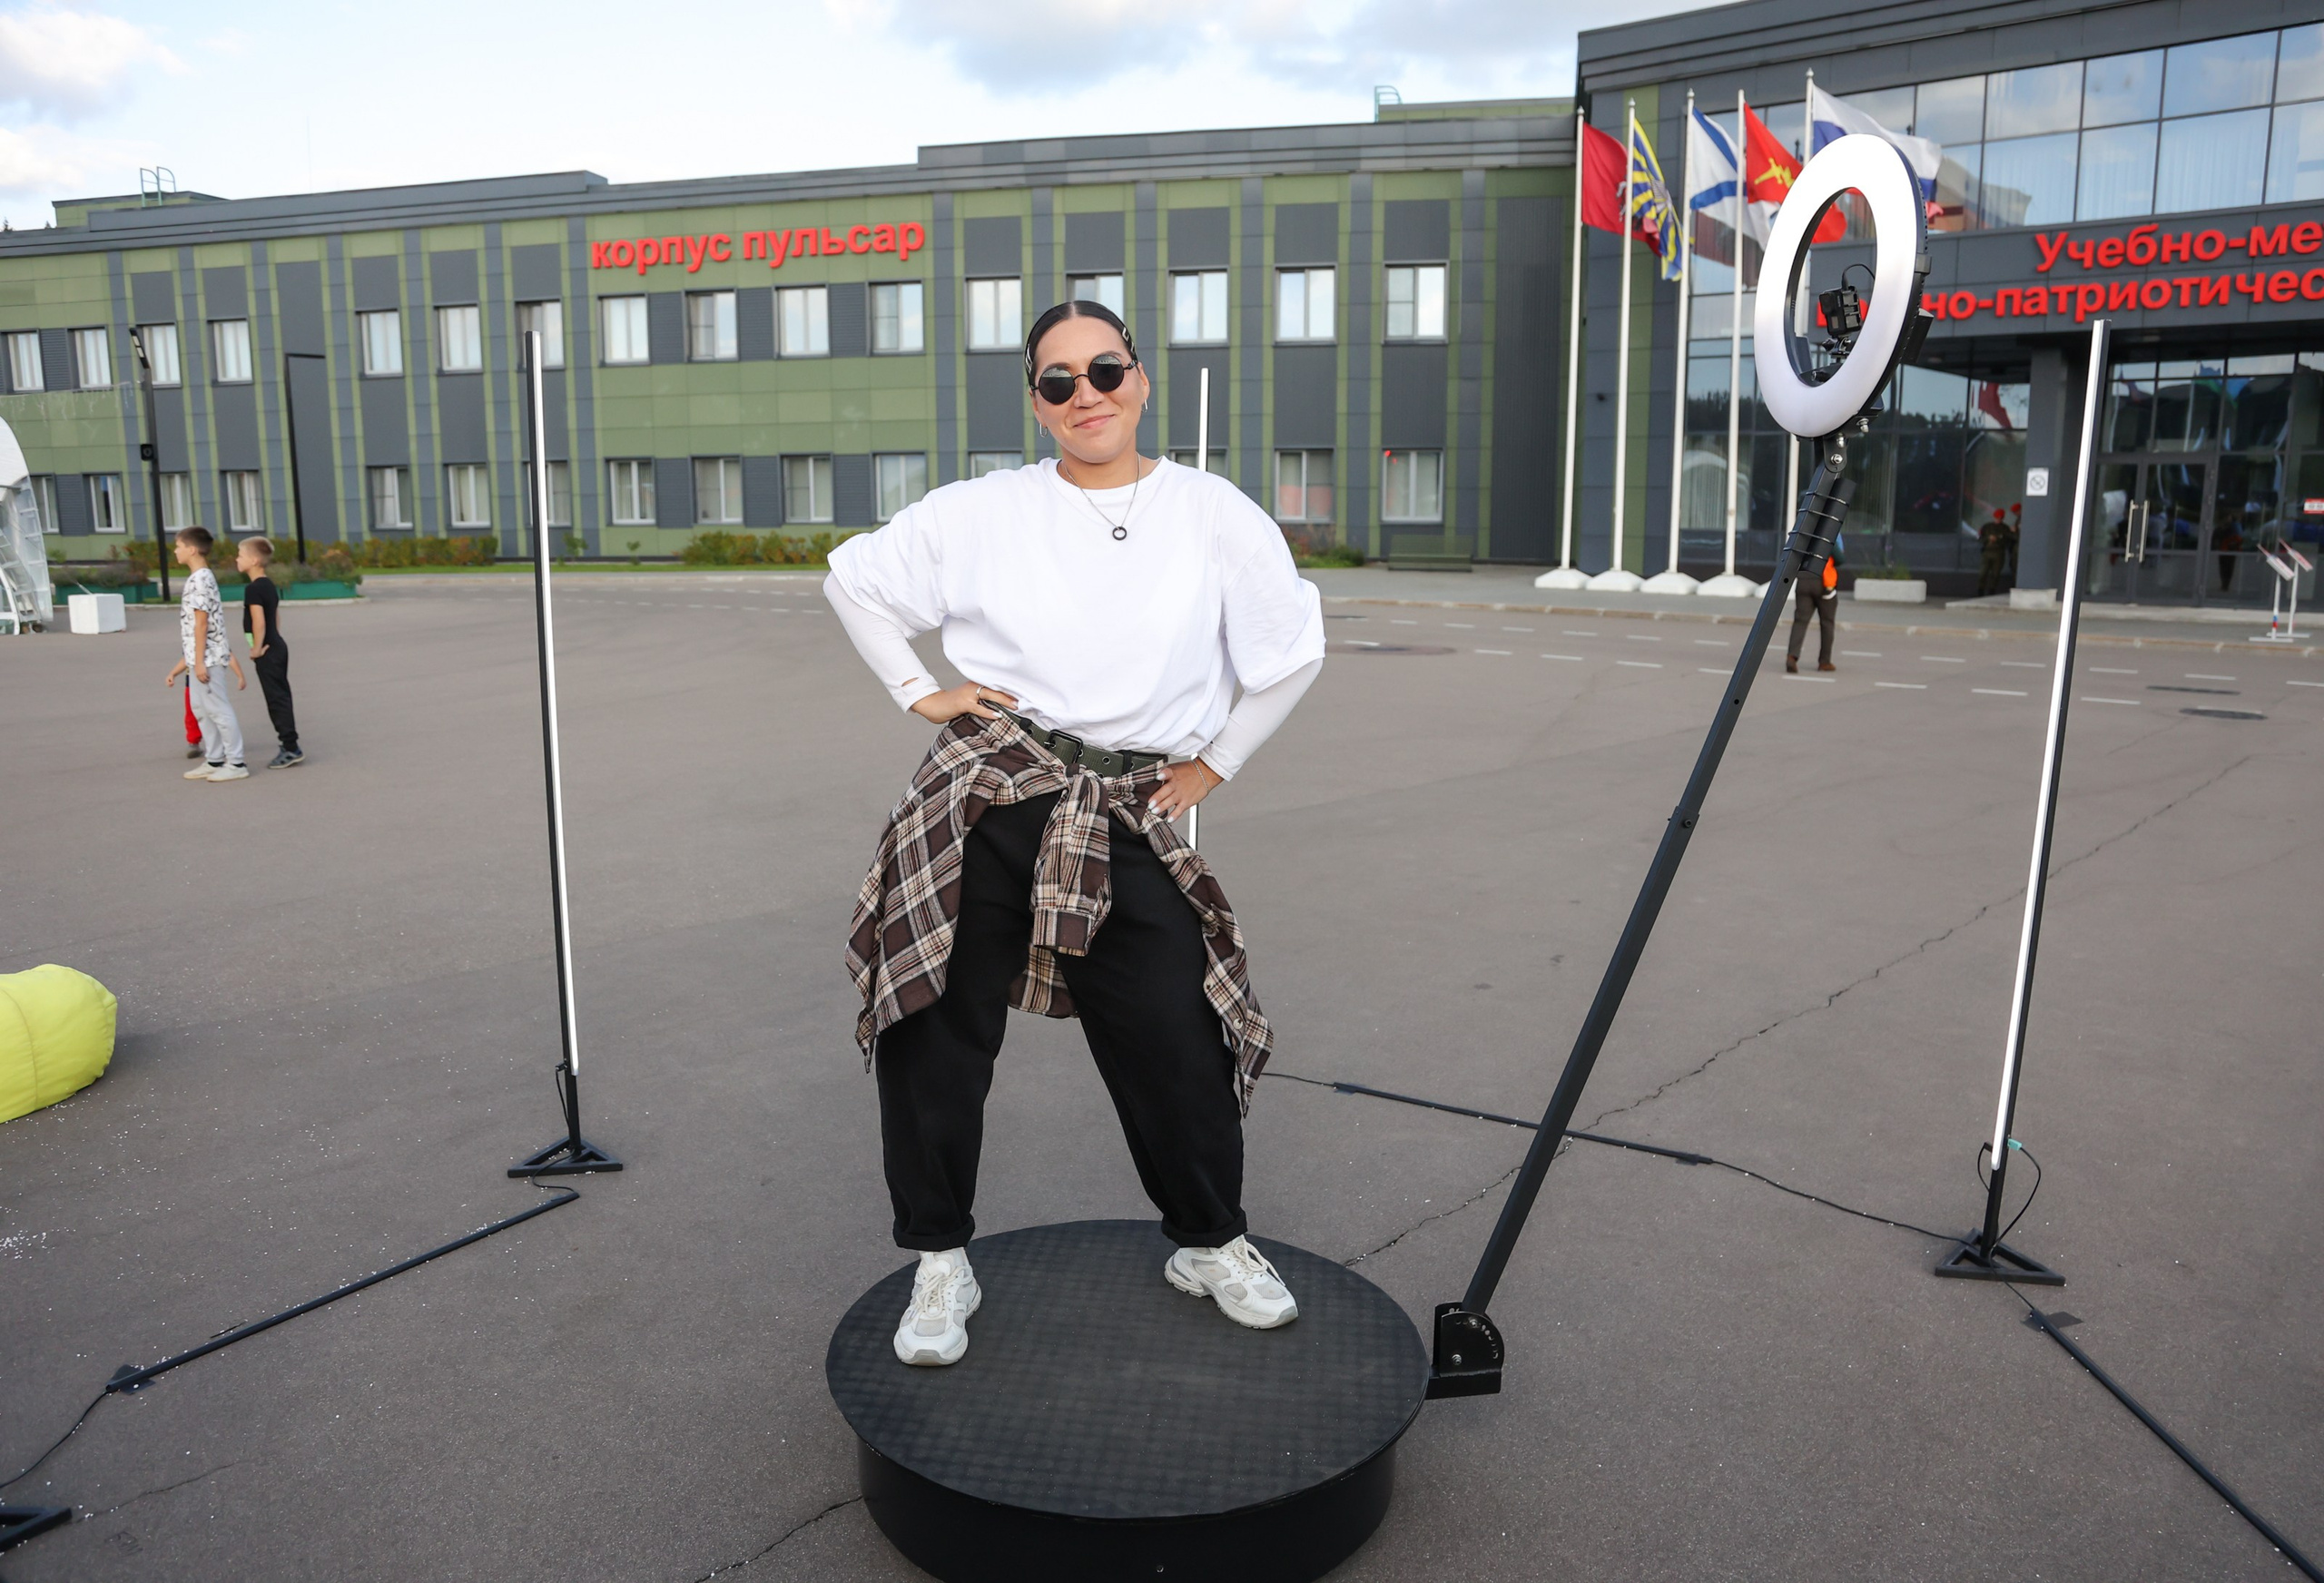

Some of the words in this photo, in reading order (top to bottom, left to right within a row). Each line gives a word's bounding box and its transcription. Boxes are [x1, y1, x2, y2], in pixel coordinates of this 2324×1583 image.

[591, 232, 732, 275] корпус
[743, 221, 926, 269] пульсар
[2034, 221, 2324, 272] Учебно-ме
[1816, 268, 2324, 327] но-патриотичес
